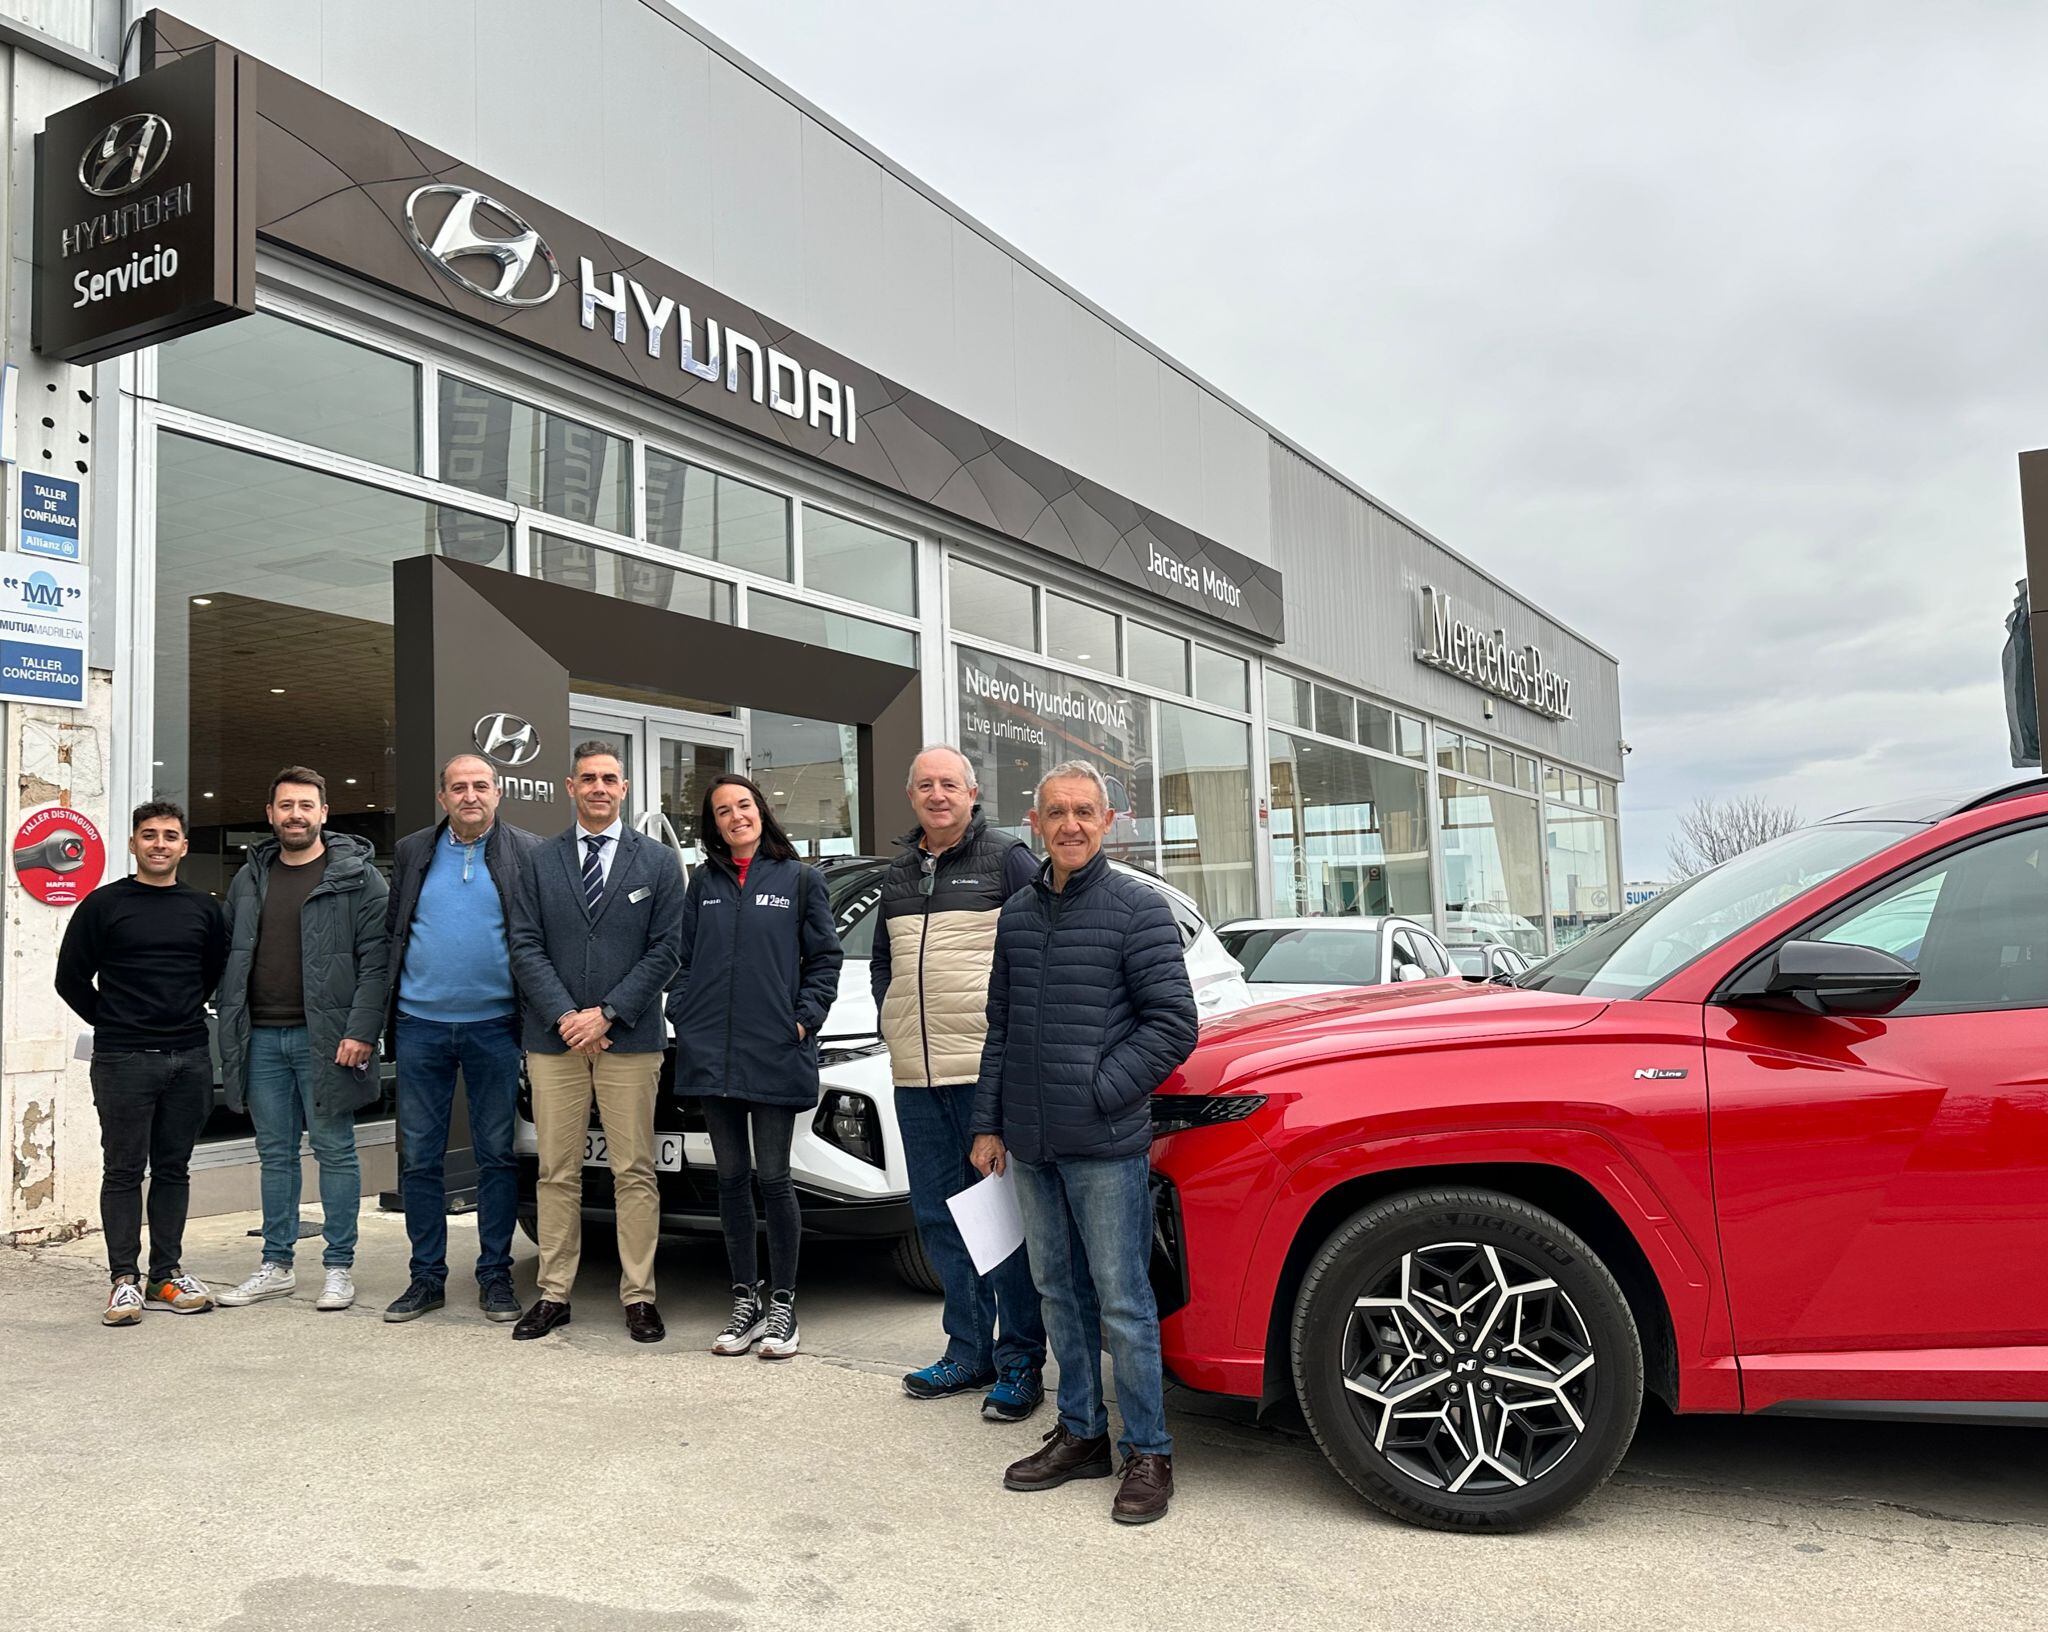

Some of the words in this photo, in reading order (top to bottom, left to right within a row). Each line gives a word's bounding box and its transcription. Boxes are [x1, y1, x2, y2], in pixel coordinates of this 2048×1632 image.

[62, 182, 191, 258] HYUNDAI
[73, 243, 178, 308] Servicio
[579, 256, 857, 444] HYUNDAI
[33, 485, 67, 501] TALLER
[44, 500, 57, 511] DE
[23, 508, 77, 528] CONFIANZA
[25, 535, 60, 551] Allianz
[1147, 542, 1200, 592] Jacarsa
[1202, 566, 1241, 608] Motor
[20, 656, 62, 671] TALLER
[1422, 585, 1573, 720] Mercedes-Benz
[2, 667, 80, 685] CONCERTADO
[965, 667, 1019, 704] Nuevo
[1023, 681, 1085, 720] Hyundai
[1088, 699, 1128, 730] KONA
[966, 712, 991, 735] Live
[993, 720, 1047, 746] unlimited.
[21, 812, 50, 836] TALLER
[51, 810, 98, 841] DISTINGUIDO
